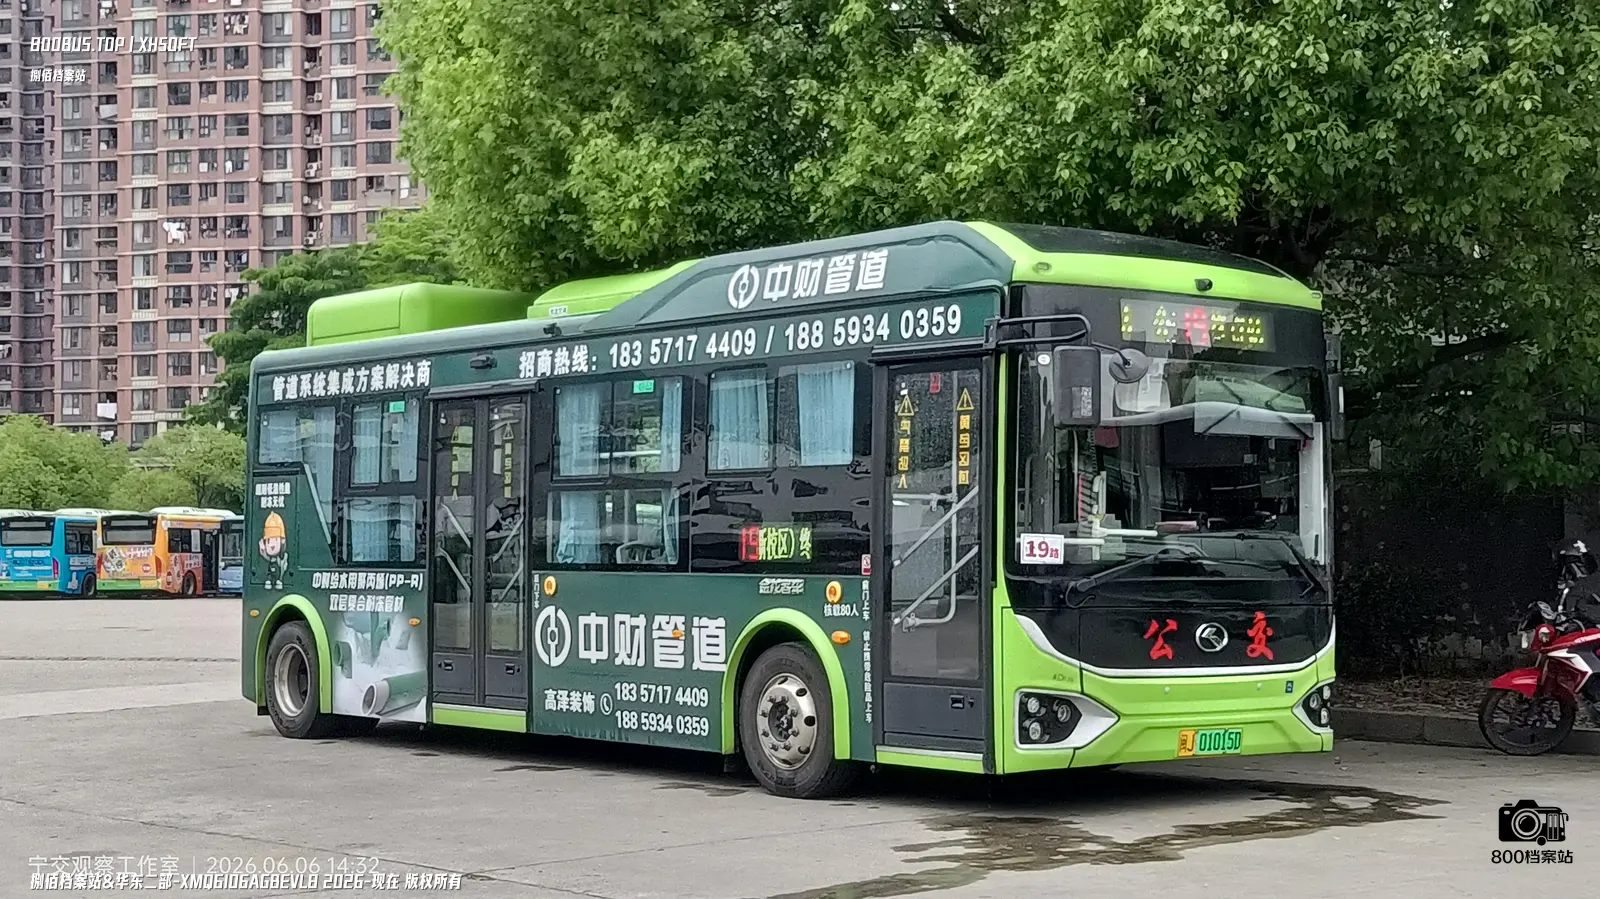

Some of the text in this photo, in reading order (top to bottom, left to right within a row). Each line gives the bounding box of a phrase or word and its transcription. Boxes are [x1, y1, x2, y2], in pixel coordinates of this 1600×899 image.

[764, 250, 889, 301] 中财管道
[609, 341, 642, 368] 183
[650, 335, 698, 364] 5717
[705, 328, 756, 359] 4409
[785, 320, 823, 351] 188
[833, 313, 890, 347] 5934
[900, 304, 962, 339] 0359
[272, 359, 432, 401] 管道系统集成方案解决商
[578, 611, 727, 672] 中财管道
[1144, 611, 1274, 660] 公 交
[544, 688, 596, 714] 高泽装饰
[614, 682, 709, 707] 183 5717 4409
[615, 710, 709, 736] 188 5934 0359
